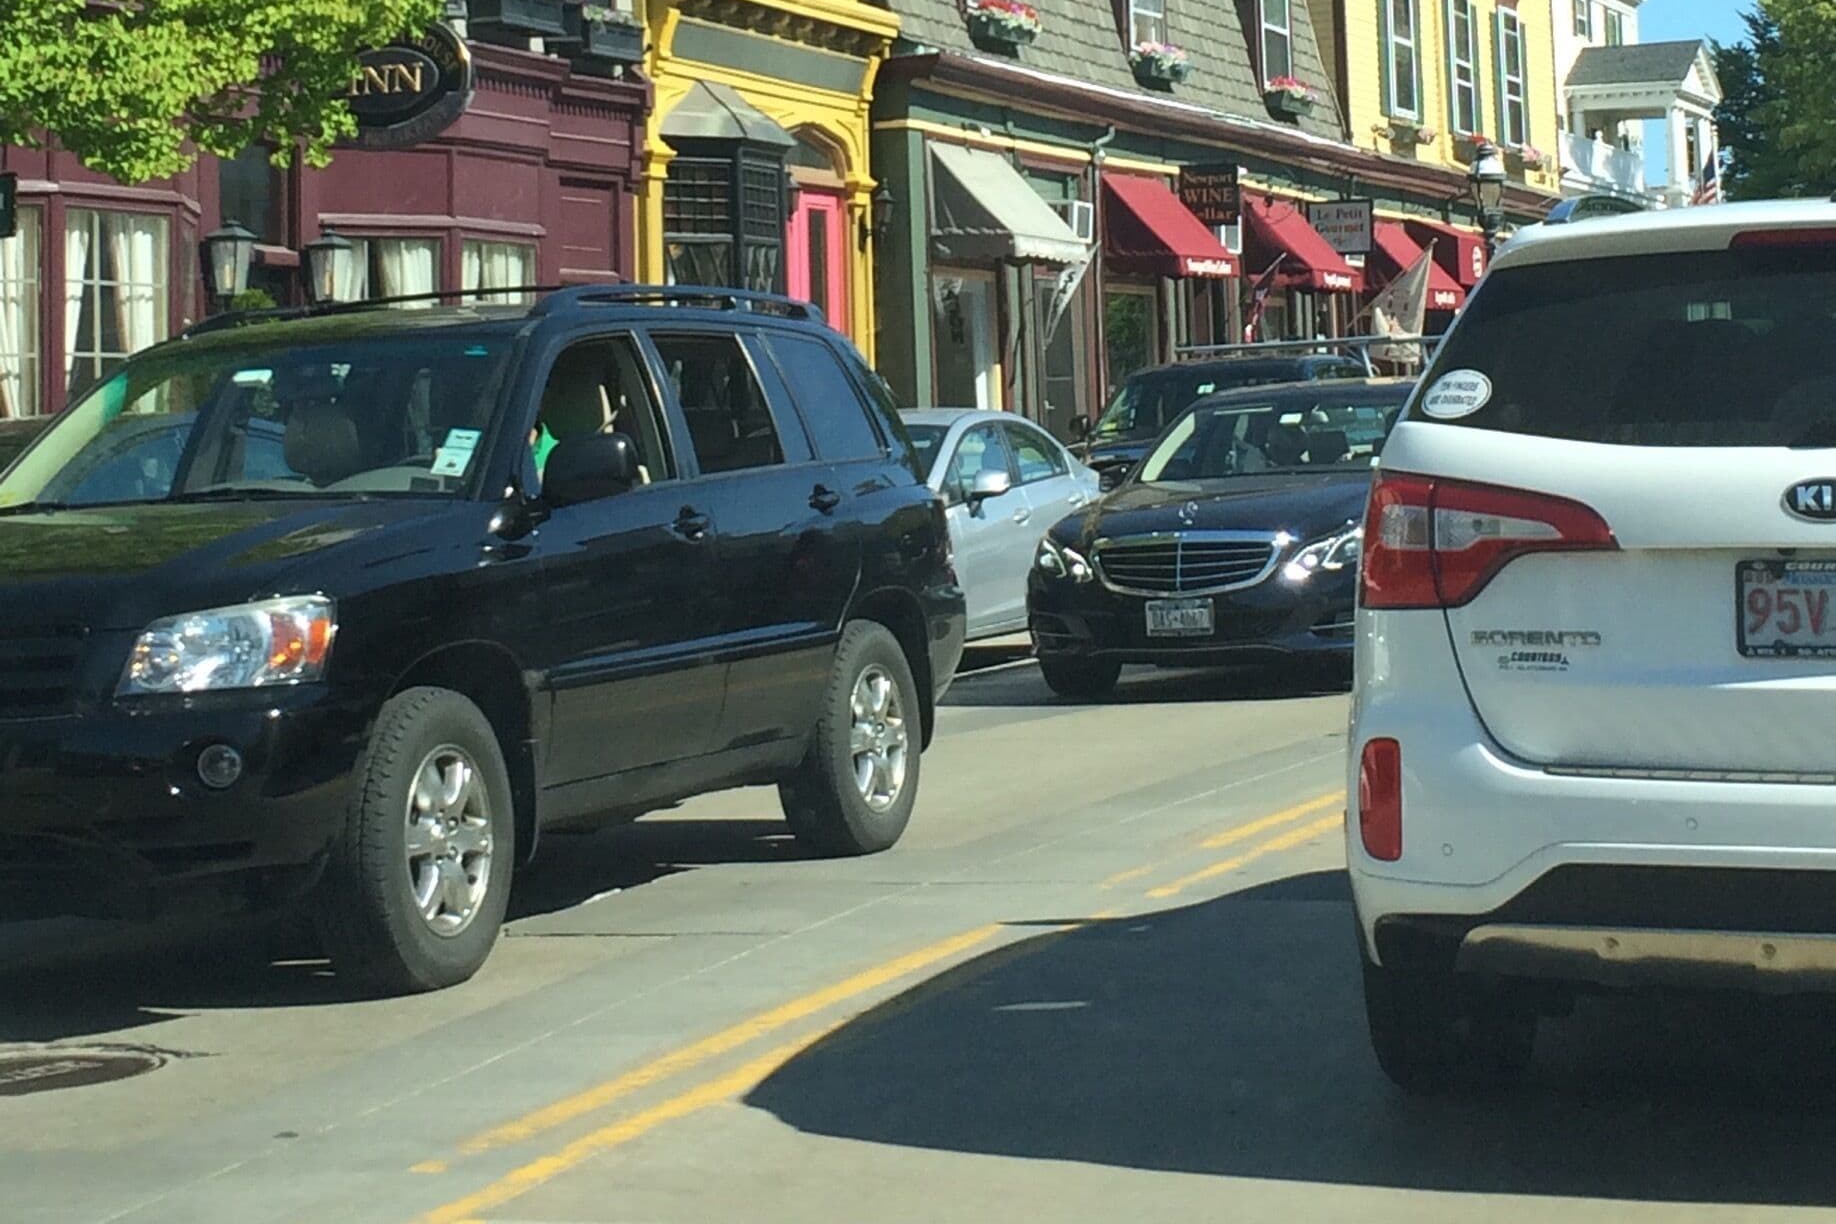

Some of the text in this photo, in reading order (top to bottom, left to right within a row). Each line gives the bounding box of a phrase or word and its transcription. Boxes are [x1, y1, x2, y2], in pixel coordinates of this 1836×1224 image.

[346, 61, 424, 95] INN
[1183, 187, 1234, 204] WINE
[1194, 207, 1234, 220] ellar
[1335, 208, 1363, 220] Petit
[1796, 485, 1834, 512] KI
[1747, 587, 1829, 637] 95V
[1470, 630, 1601, 646] SORENTO
